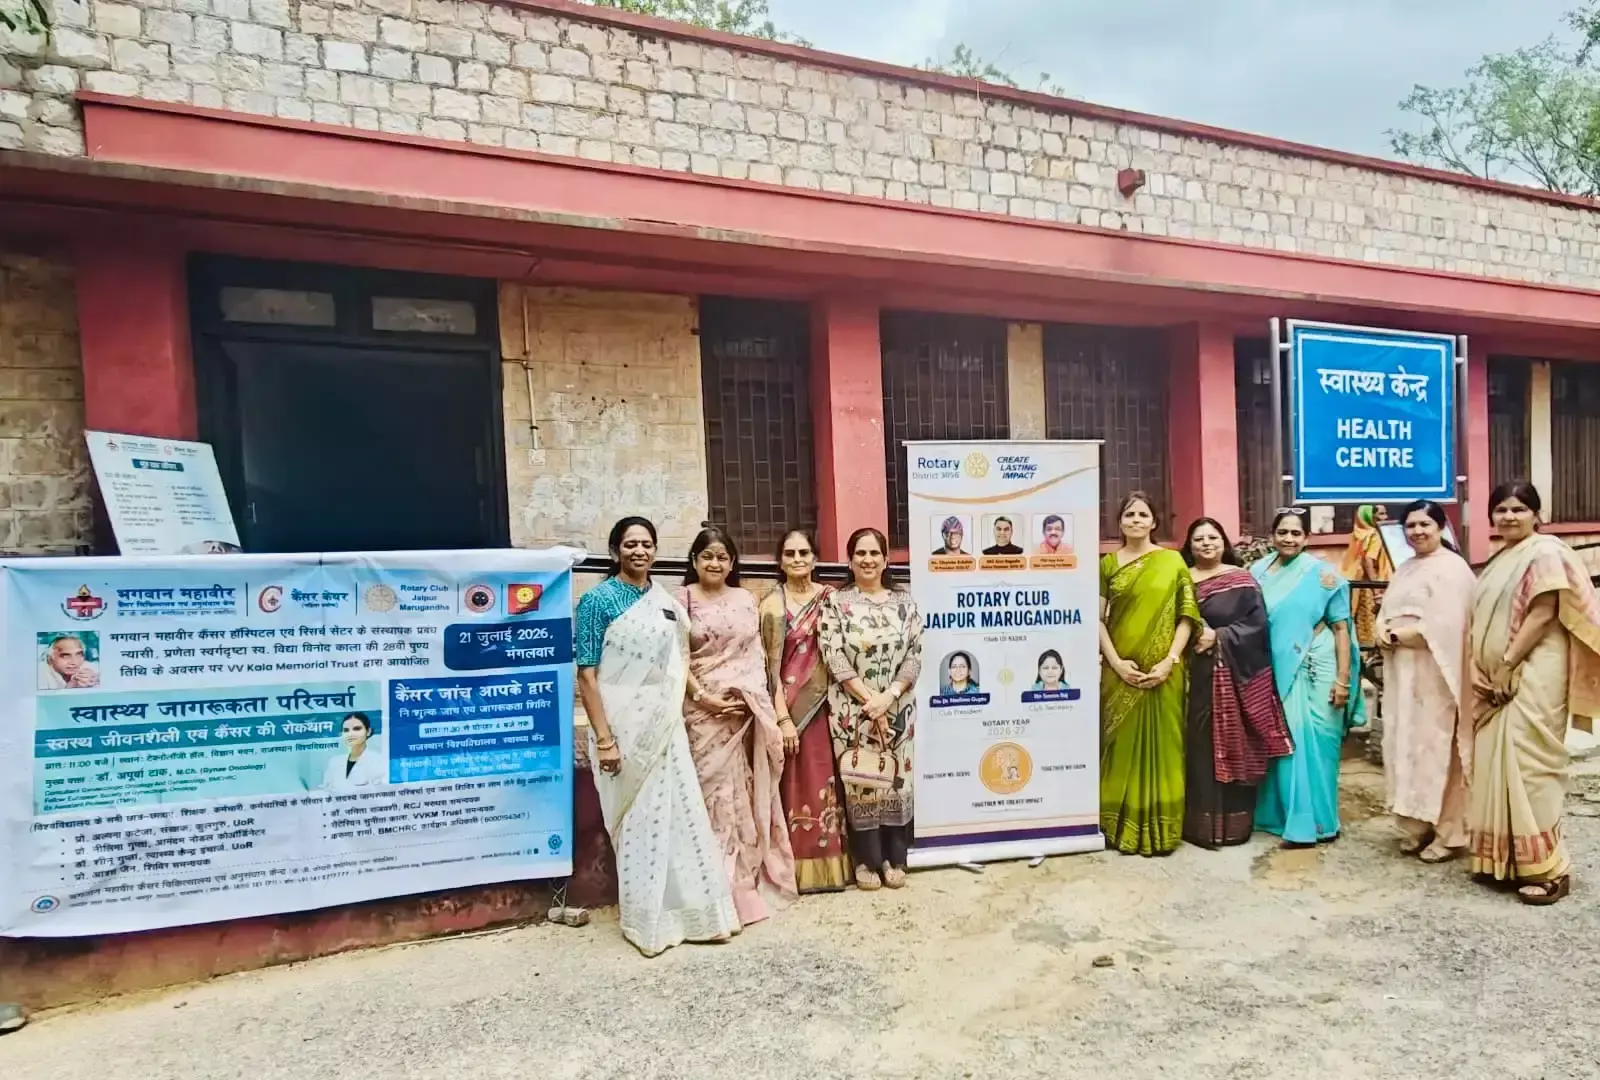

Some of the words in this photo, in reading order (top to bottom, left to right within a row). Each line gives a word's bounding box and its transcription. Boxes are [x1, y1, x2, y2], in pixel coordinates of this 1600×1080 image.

[1316, 368, 1386, 396] स्वास्थ्य
[1388, 365, 1430, 403] केन्द्र
[1336, 417, 1412, 441] HEALTH
[917, 457, 960, 471] Rotary
[997, 456, 1030, 464] CREATE
[1335, 447, 1415, 469] CENTRE
[1000, 464, 1038, 472] LASTING
[912, 471, 939, 480] District
[1002, 472, 1036, 480] IMPACT
[117, 588, 174, 601] भगवान
[180, 584, 236, 601] महावीर
[400, 584, 427, 593] Rotary
[429, 583, 449, 592] Club
[412, 594, 438, 602] Jaipur
[956, 591, 1011, 608] ROTARY
[1015, 590, 1051, 606] CLUB
[400, 602, 450, 613] Marugandha
[923, 611, 976, 630] JAIPUR
[981, 608, 1082, 628] MARUGANDHA
[156, 628, 194, 642] महावीर
[230, 626, 275, 639] हॉस्पिटल
[280, 625, 295, 638] एवं
[300, 624, 326, 637] रिसर्च
[357, 624, 367, 635] के
[459, 632, 471, 644] 21
[477, 627, 513, 647] जुलाई
[164, 645, 195, 658] प्रणेता
[275, 642, 298, 655] विद्या
[302, 642, 331, 653] विनोद
[336, 643, 361, 652] काला
[365, 639, 378, 651] की
[409, 642, 429, 654] पुण्य
[505, 646, 555, 660] मंगलवार
[120, 664, 147, 677] तिथि
[152, 664, 164, 676] के
[169, 664, 206, 675] अवसर
[209, 664, 223, 673] पर
[228, 664, 244, 673] VV
[247, 663, 273, 672] Kala
[276, 660, 329, 671] Memorial
[332, 660, 359, 669] Trust
[363, 657, 383, 669] द्वारा
[387, 656, 429, 667] आयोजित
[395, 682, 433, 703] कैंसर
[438, 684, 472, 701] जांच
[480, 680, 523, 698] आपके
[527, 680, 554, 696] द्वार
[70, 703, 149, 723] स्वास्थ्य
[157, 696, 269, 718] जागरूकता
[276, 685, 357, 712] परिचर्चा
[982, 719, 1009, 727] ROTARY
[1012, 718, 1031, 726] YEAR
[46, 735, 93, 751] स्वस्थ
[100, 727, 180, 747] जीवनशैली
[186, 725, 208, 743] एवं
[214, 722, 252, 740] कैंसर
[257, 720, 276, 737] की
[281, 719, 334, 735] रोकथाम
[403, 802, 421, 810] RCJ
[413, 810, 439, 820] VVKM
[441, 809, 462, 817] Trust
[233, 817, 255, 827] UoR
[378, 823, 418, 835] BMCHRC
[231, 841, 254, 851] UoR
